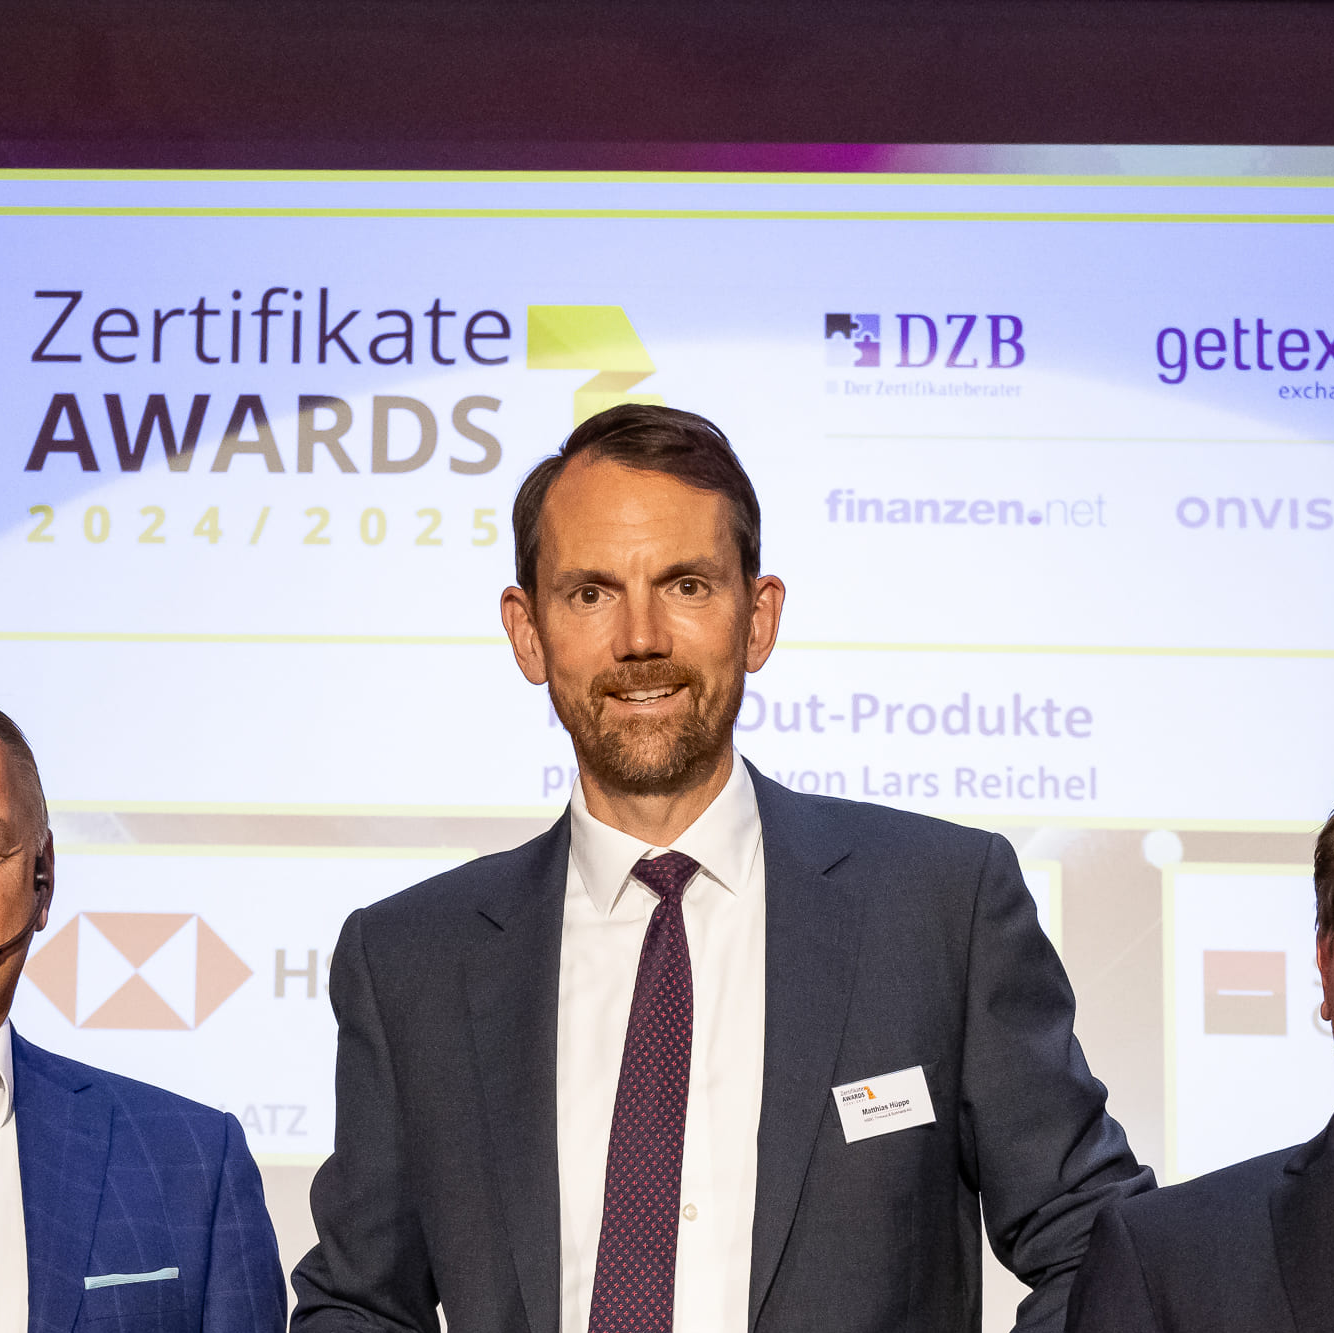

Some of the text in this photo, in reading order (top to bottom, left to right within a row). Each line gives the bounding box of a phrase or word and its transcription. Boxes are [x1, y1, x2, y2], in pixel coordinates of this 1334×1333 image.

[30, 287, 511, 365] Zertifikate
[895, 313, 1025, 368] DZB
[23, 392, 503, 476] AWARDS
[824, 488, 1108, 528] finanzen.net
[774, 764, 1098, 801] von Lars Reichel
[842, 1092, 865, 1102] AWARDS
[862, 1105, 888, 1116] Matthias
